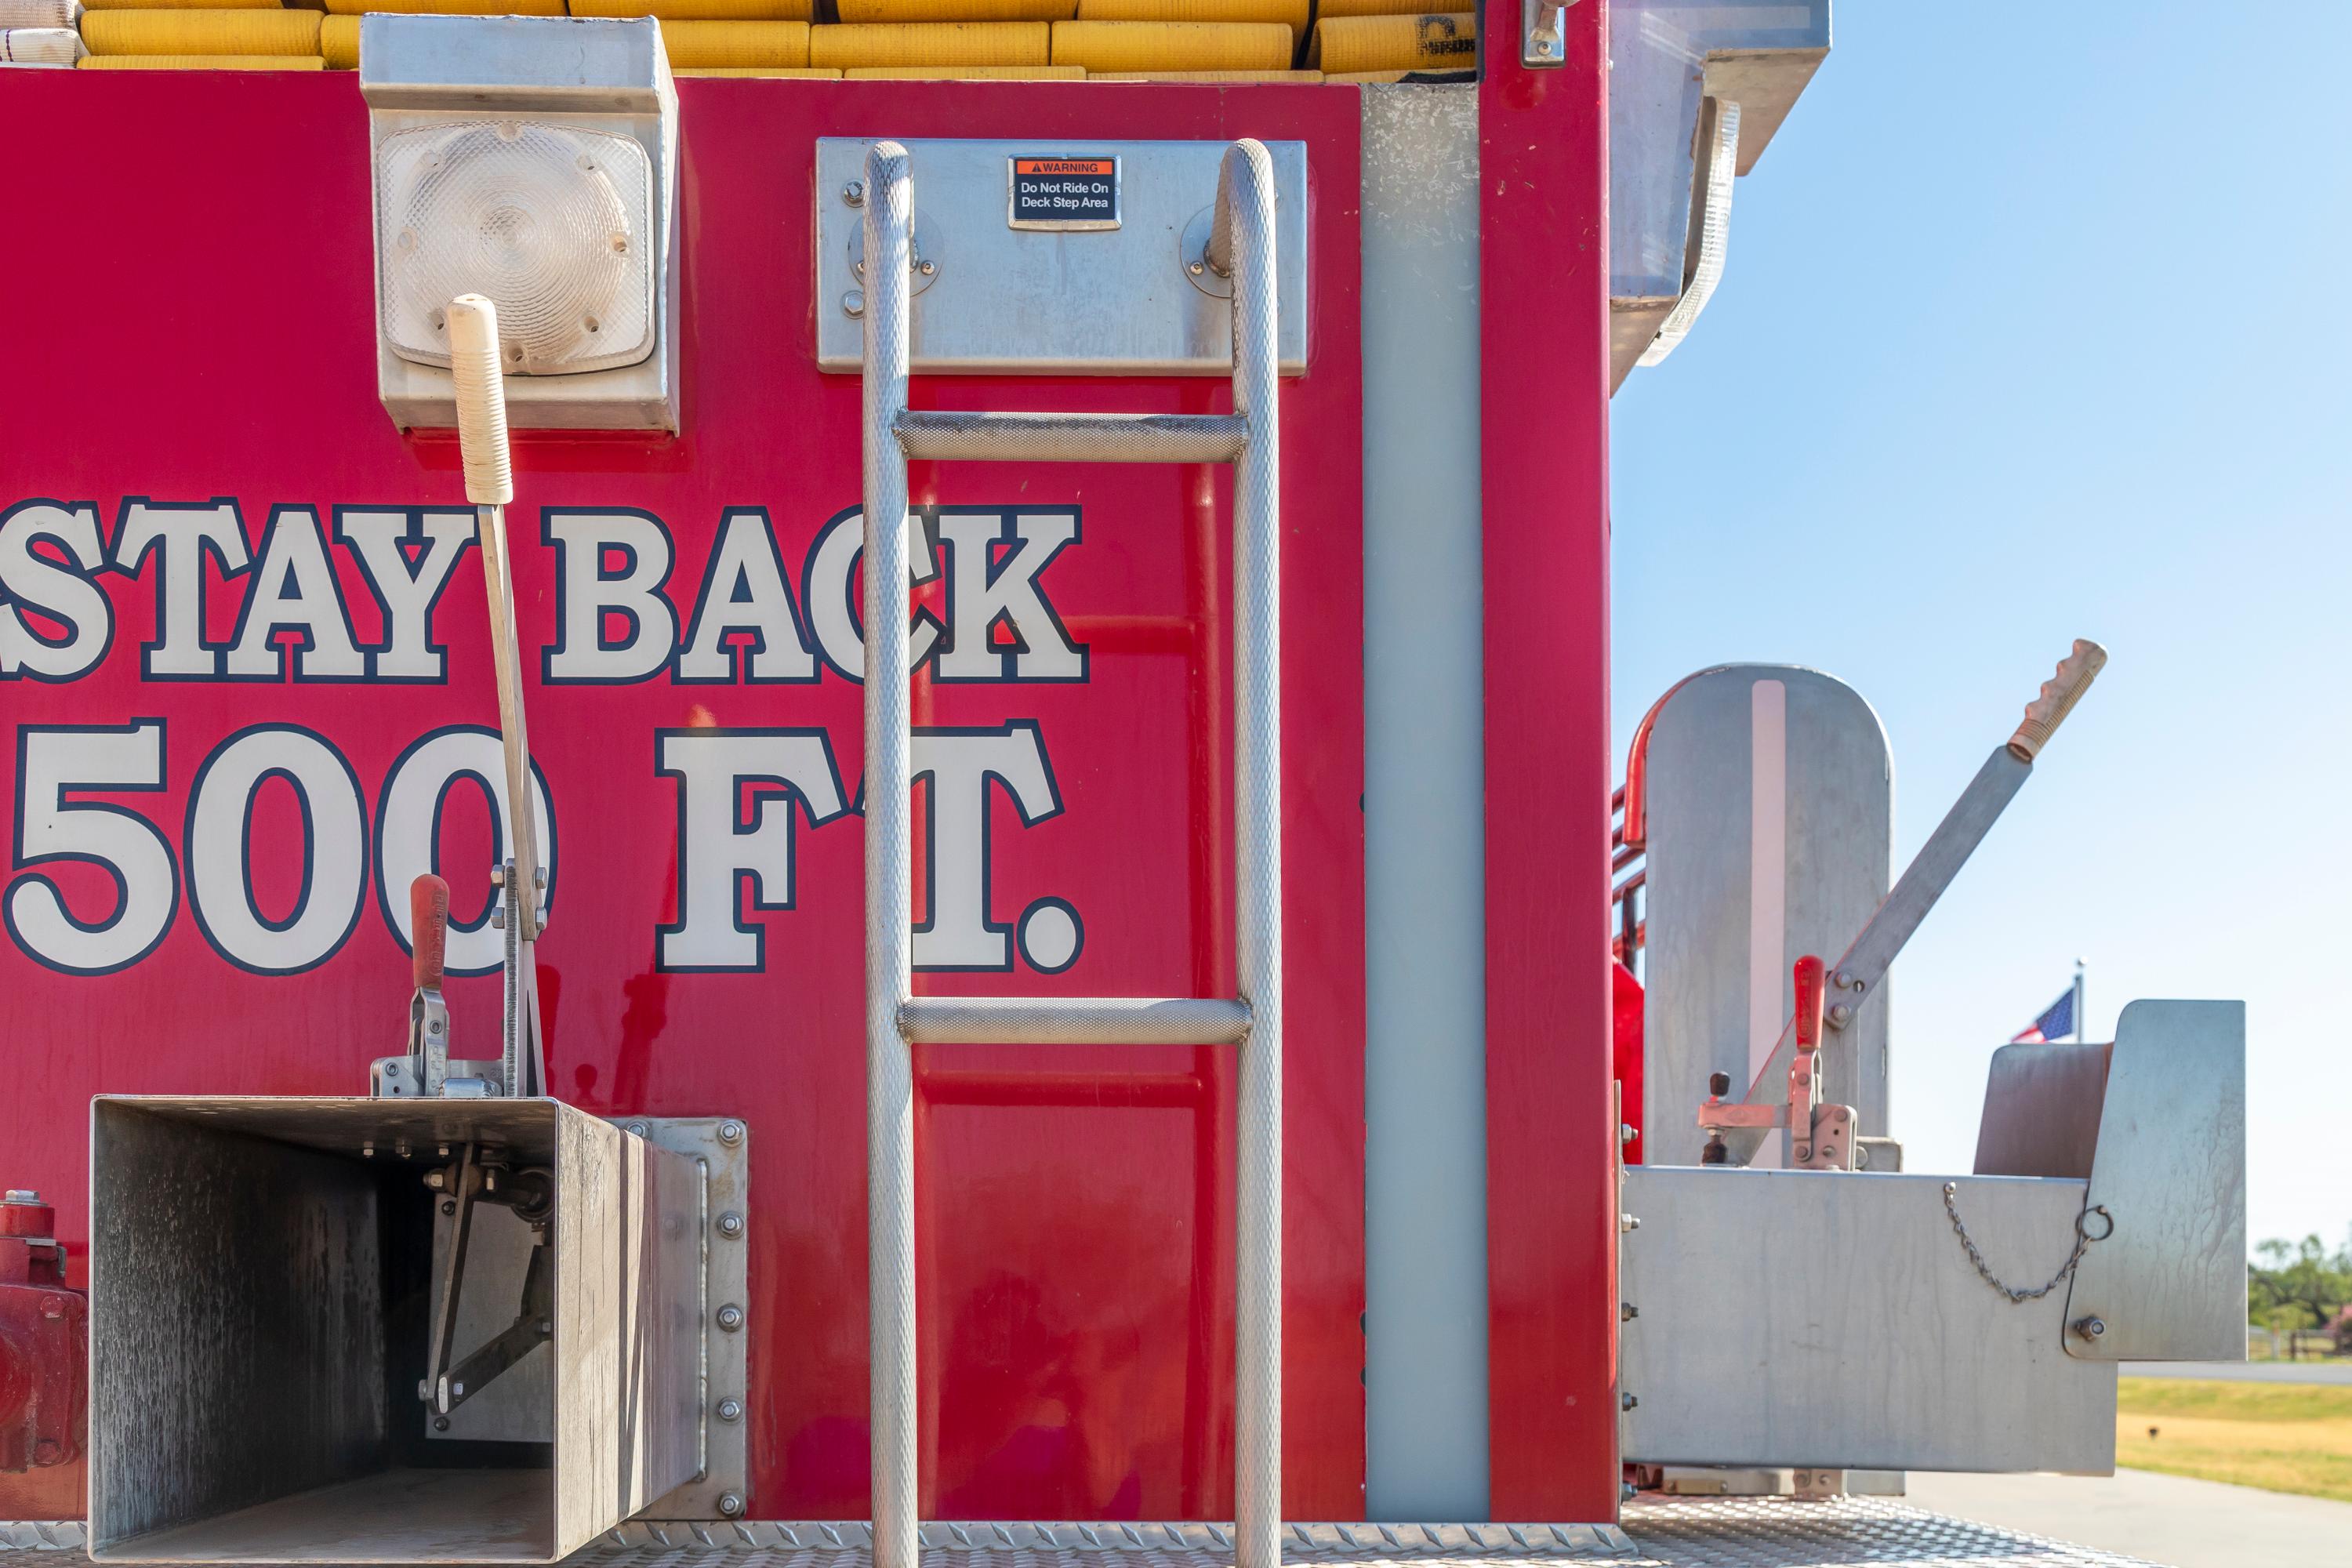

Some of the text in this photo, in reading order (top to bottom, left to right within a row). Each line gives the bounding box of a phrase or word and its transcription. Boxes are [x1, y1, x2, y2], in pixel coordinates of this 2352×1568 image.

[1044, 163, 1098, 172] WARNING
[1021, 183, 1109, 194] Do Not Ride On
[1022, 197, 1109, 209] Deck Step Area
[0, 495, 1090, 685] STAY BACK
[2, 717, 1084, 977] 500 FT.
